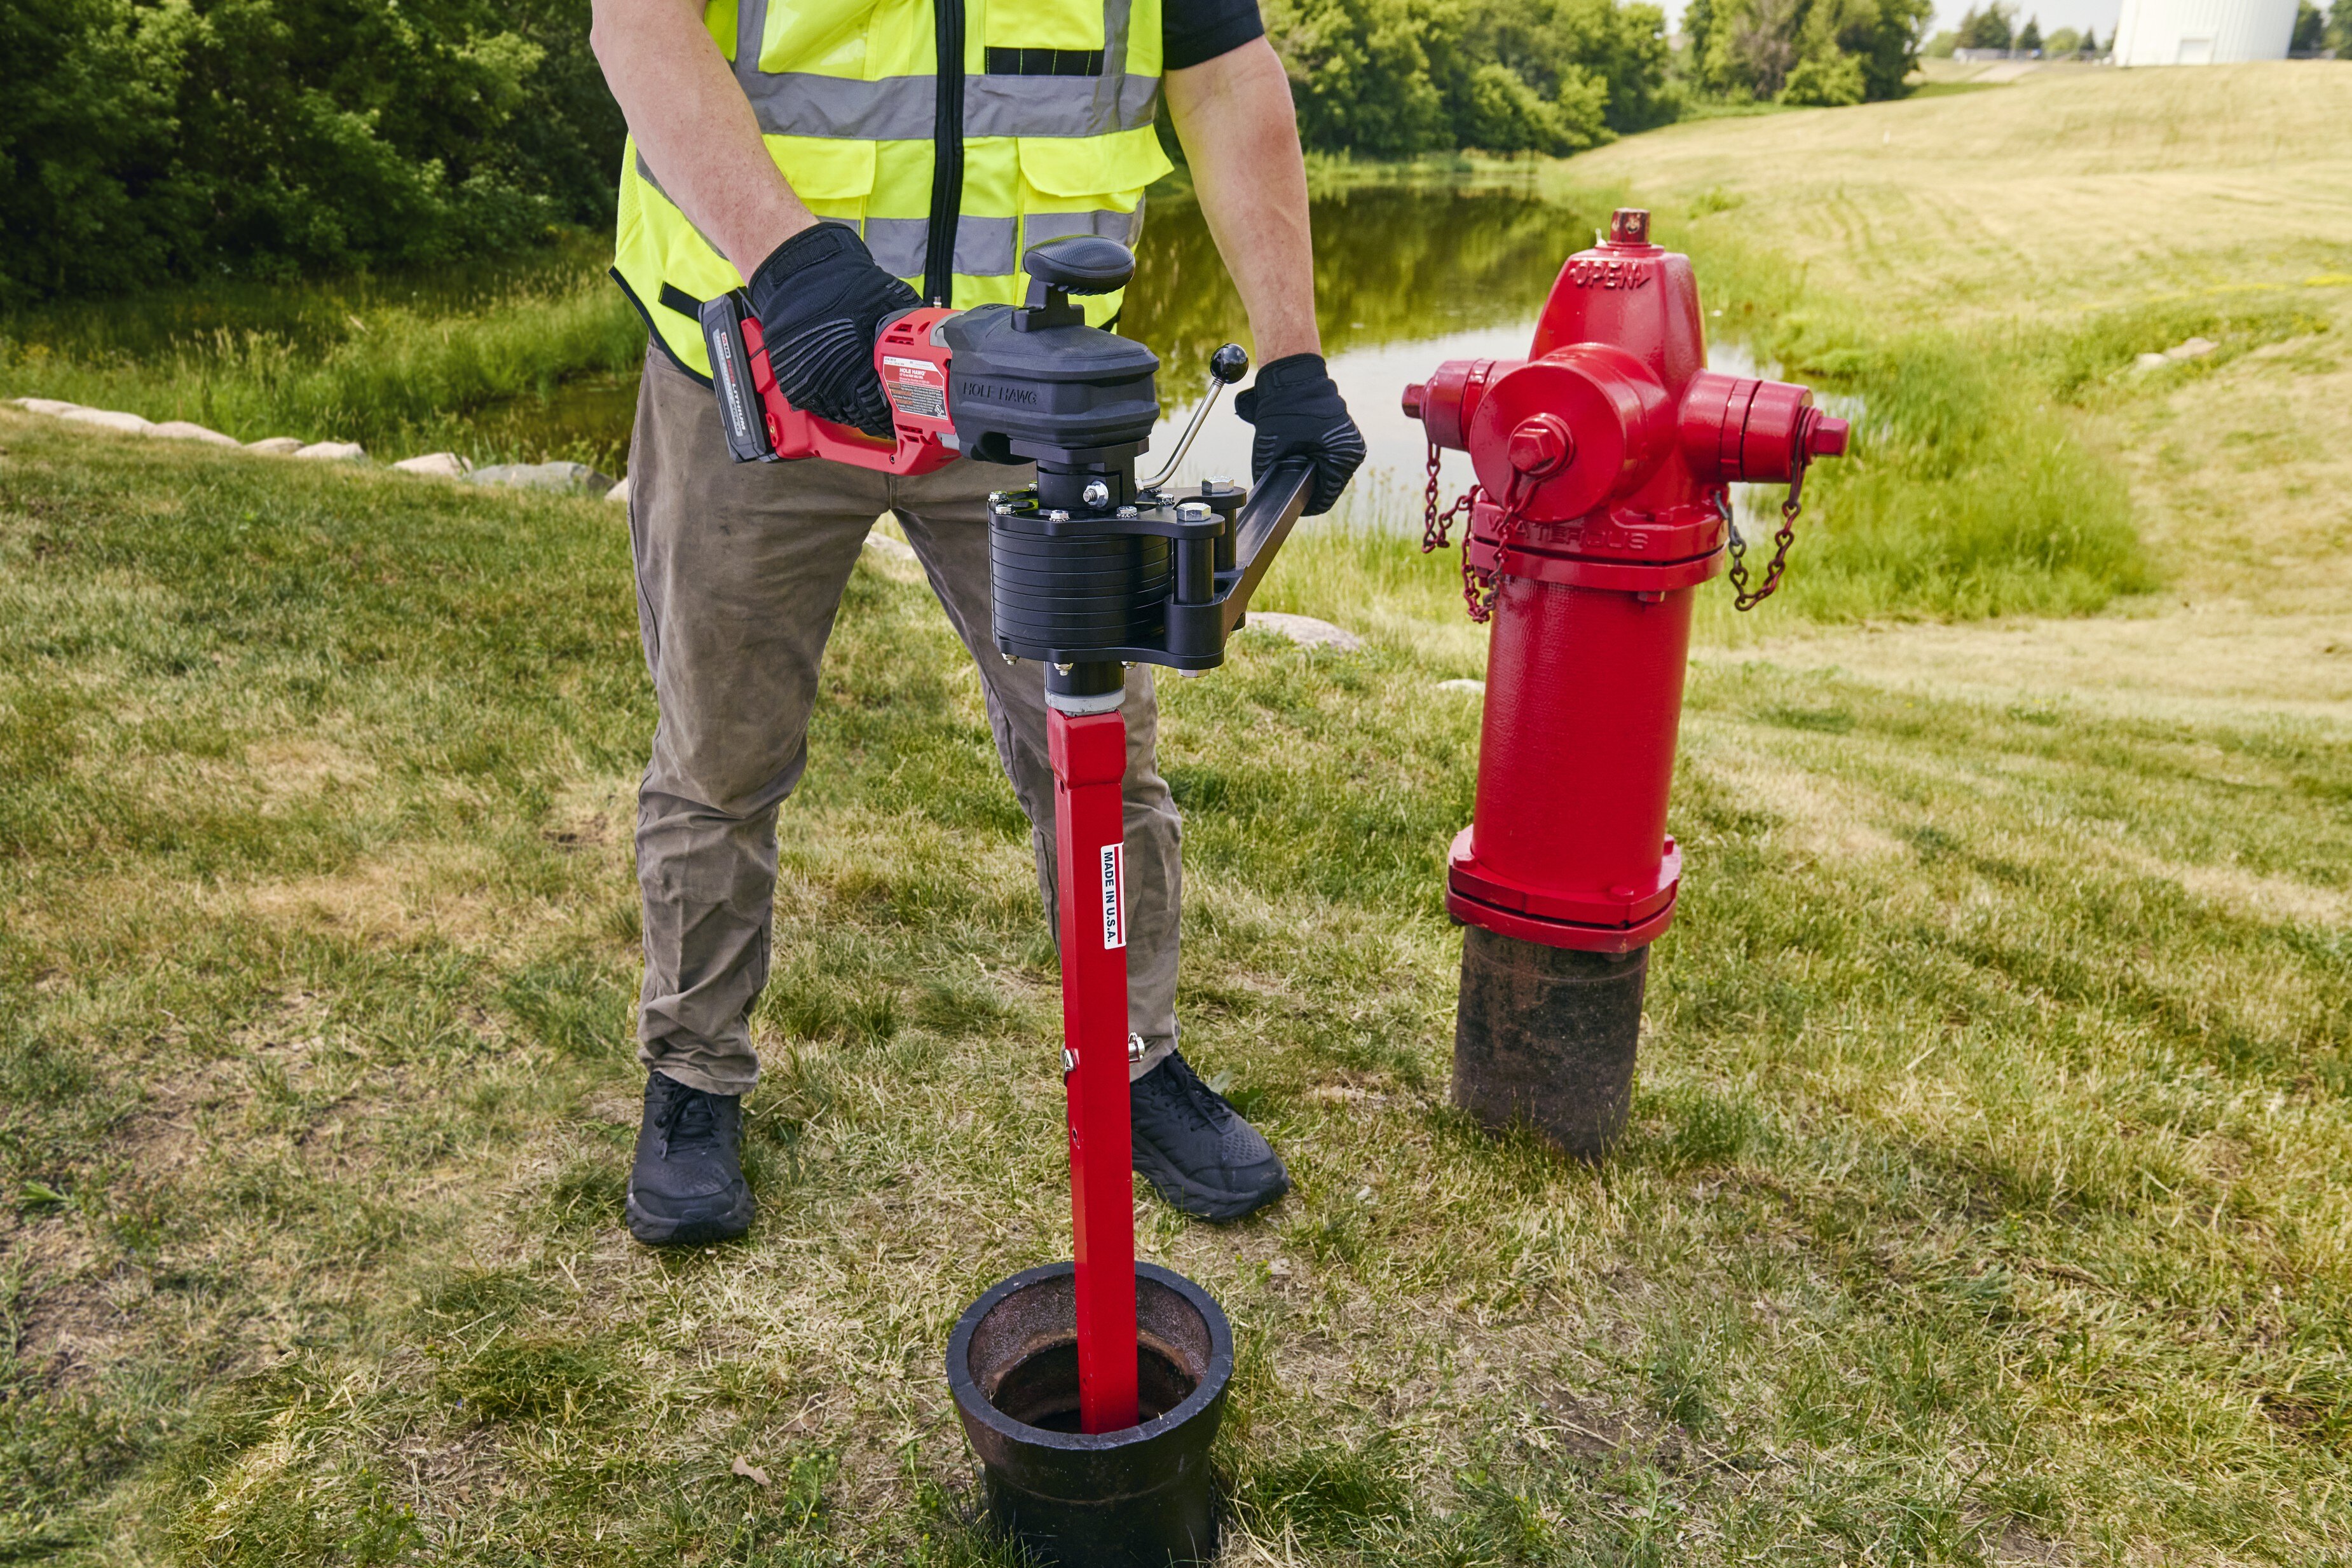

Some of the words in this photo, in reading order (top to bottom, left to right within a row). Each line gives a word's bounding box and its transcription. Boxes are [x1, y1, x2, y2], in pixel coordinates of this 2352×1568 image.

[1575, 260, 1643, 289] OPEN
[721, 334, 730, 356] M18
[716, 336, 724, 360] HIGH
[722, 362, 734, 403] OUTPUT
[962, 382, 994, 399] HOLE
[999, 386, 1037, 405] HAWG
[1104, 851, 1114, 887] MADE
[1105, 890, 1115, 903] IN
[1106, 907, 1116, 942] U.S.A.
